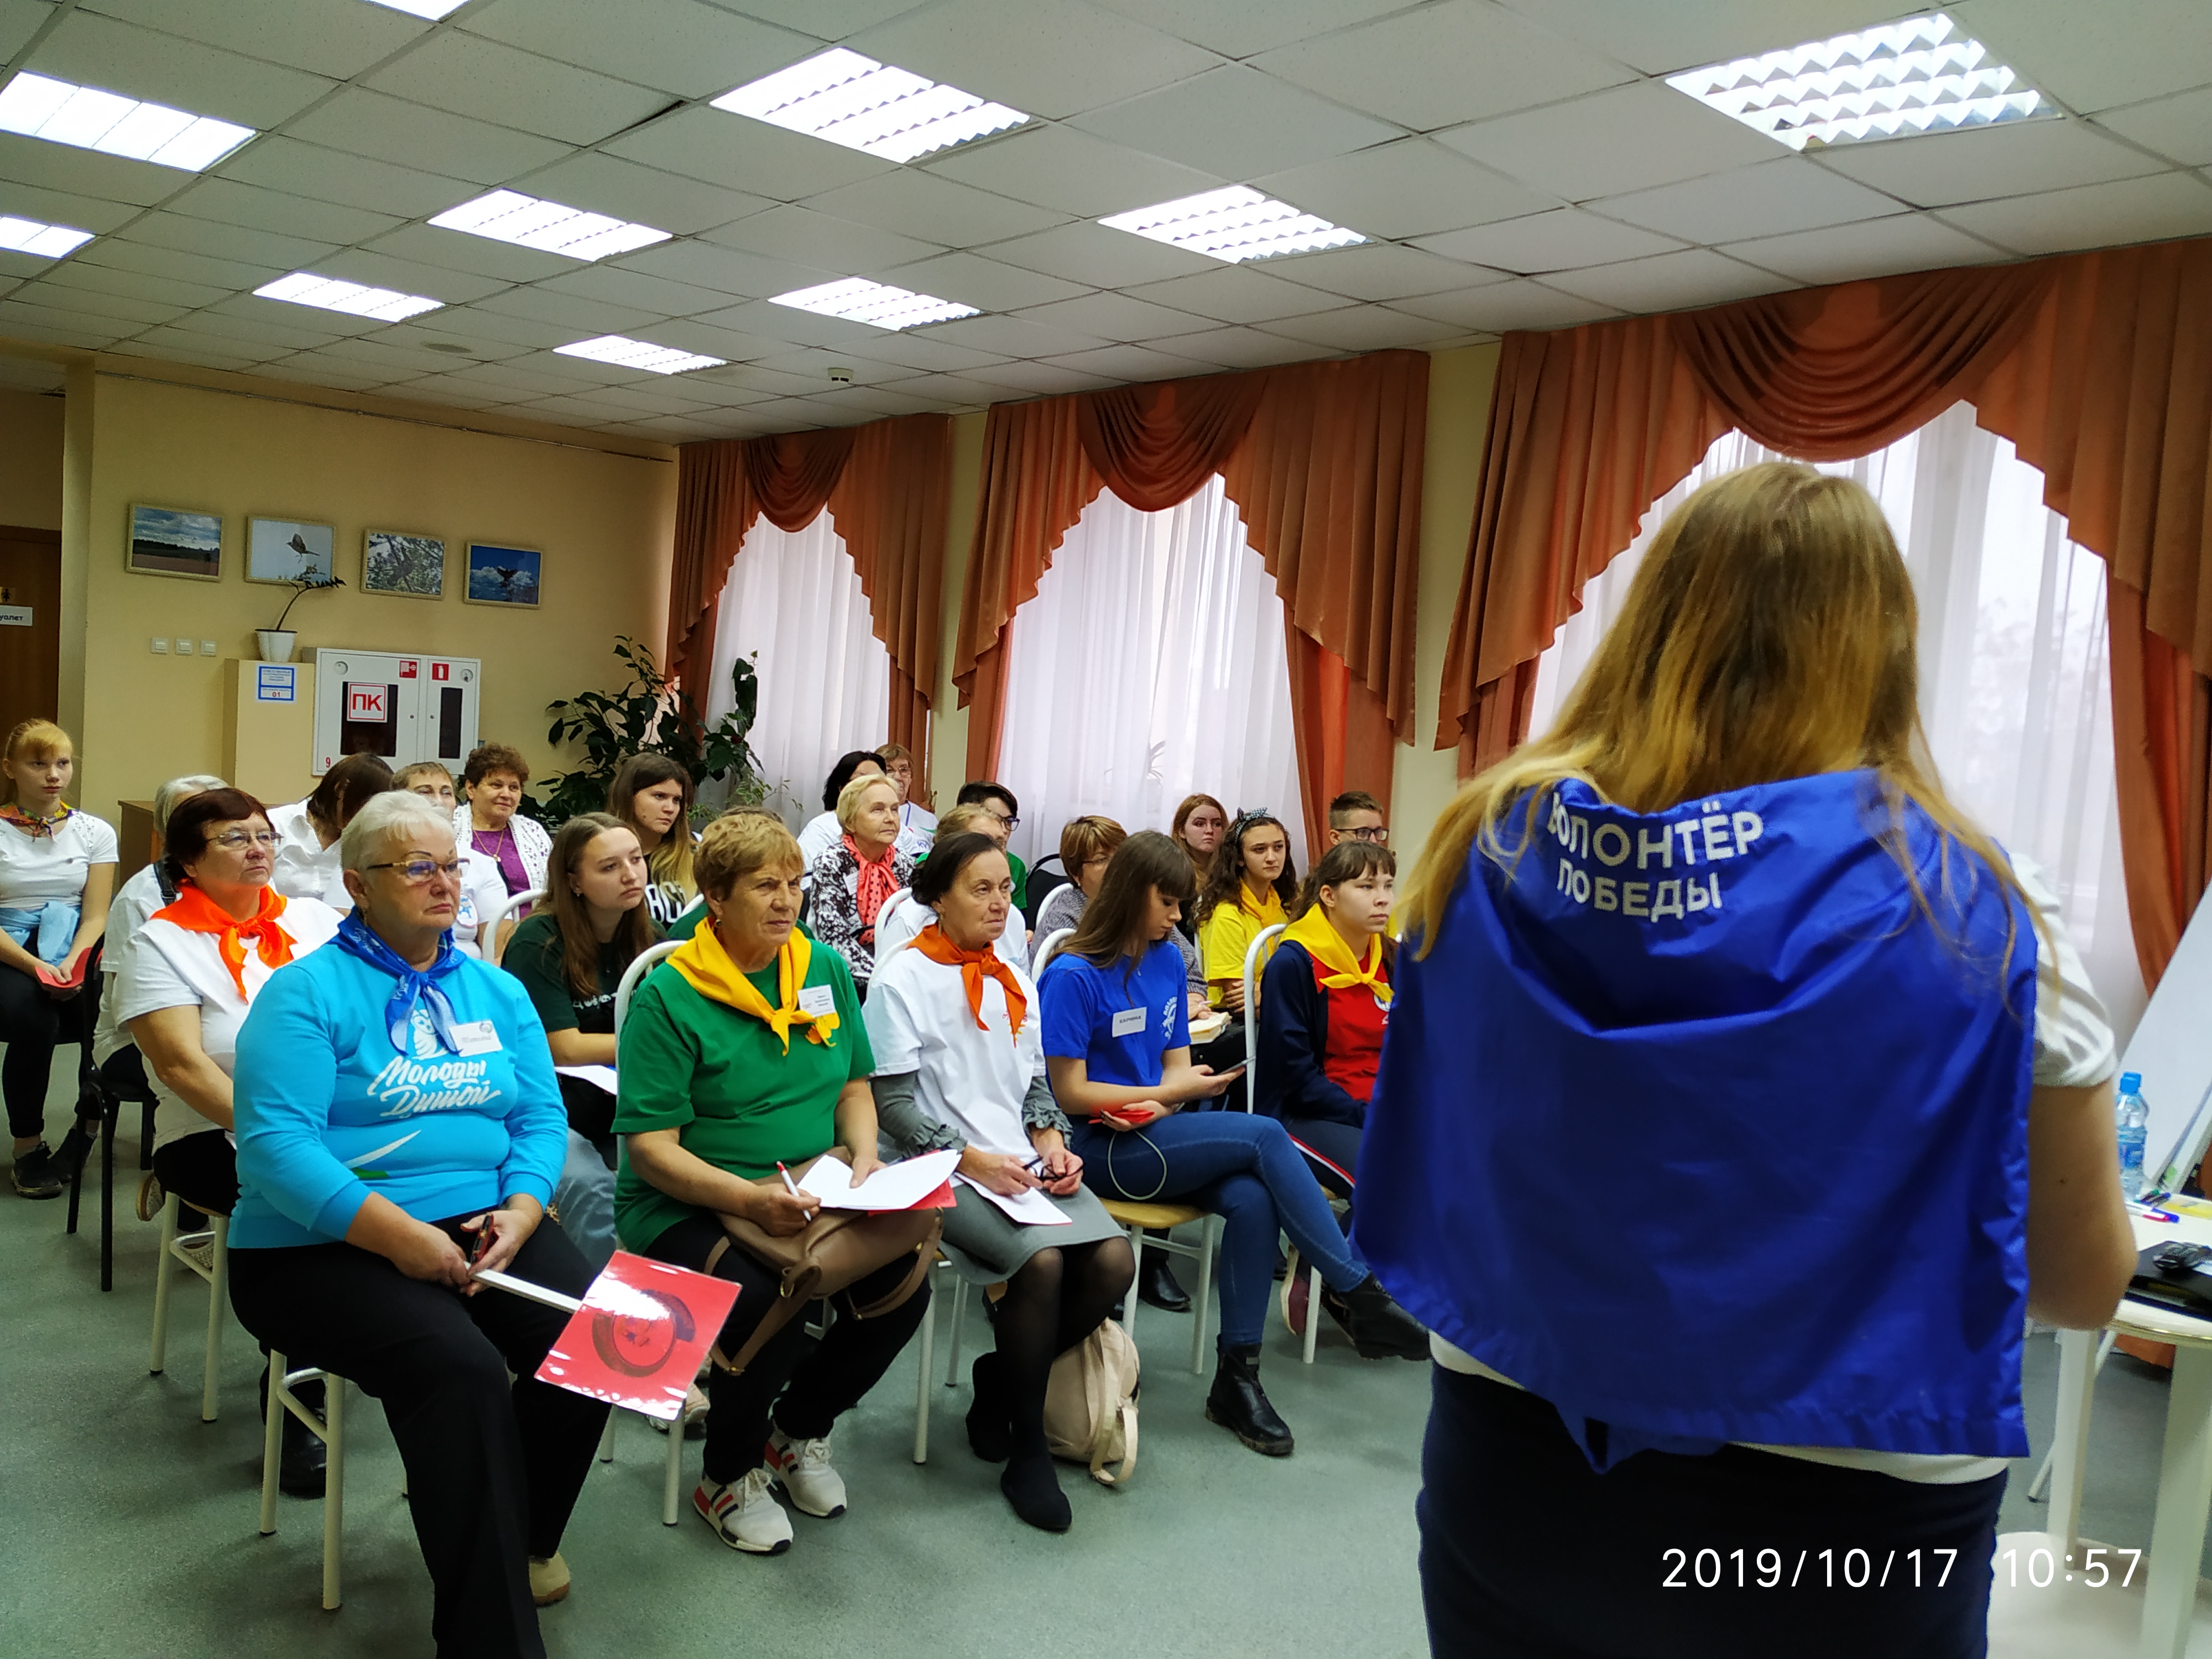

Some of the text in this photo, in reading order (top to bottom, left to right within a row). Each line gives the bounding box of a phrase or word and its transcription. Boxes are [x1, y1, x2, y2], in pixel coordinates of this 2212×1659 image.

[352, 693, 383, 712] ПК
[325, 757, 331, 768] 9
[1557, 857, 1723, 924] ПОБЕДЫ
